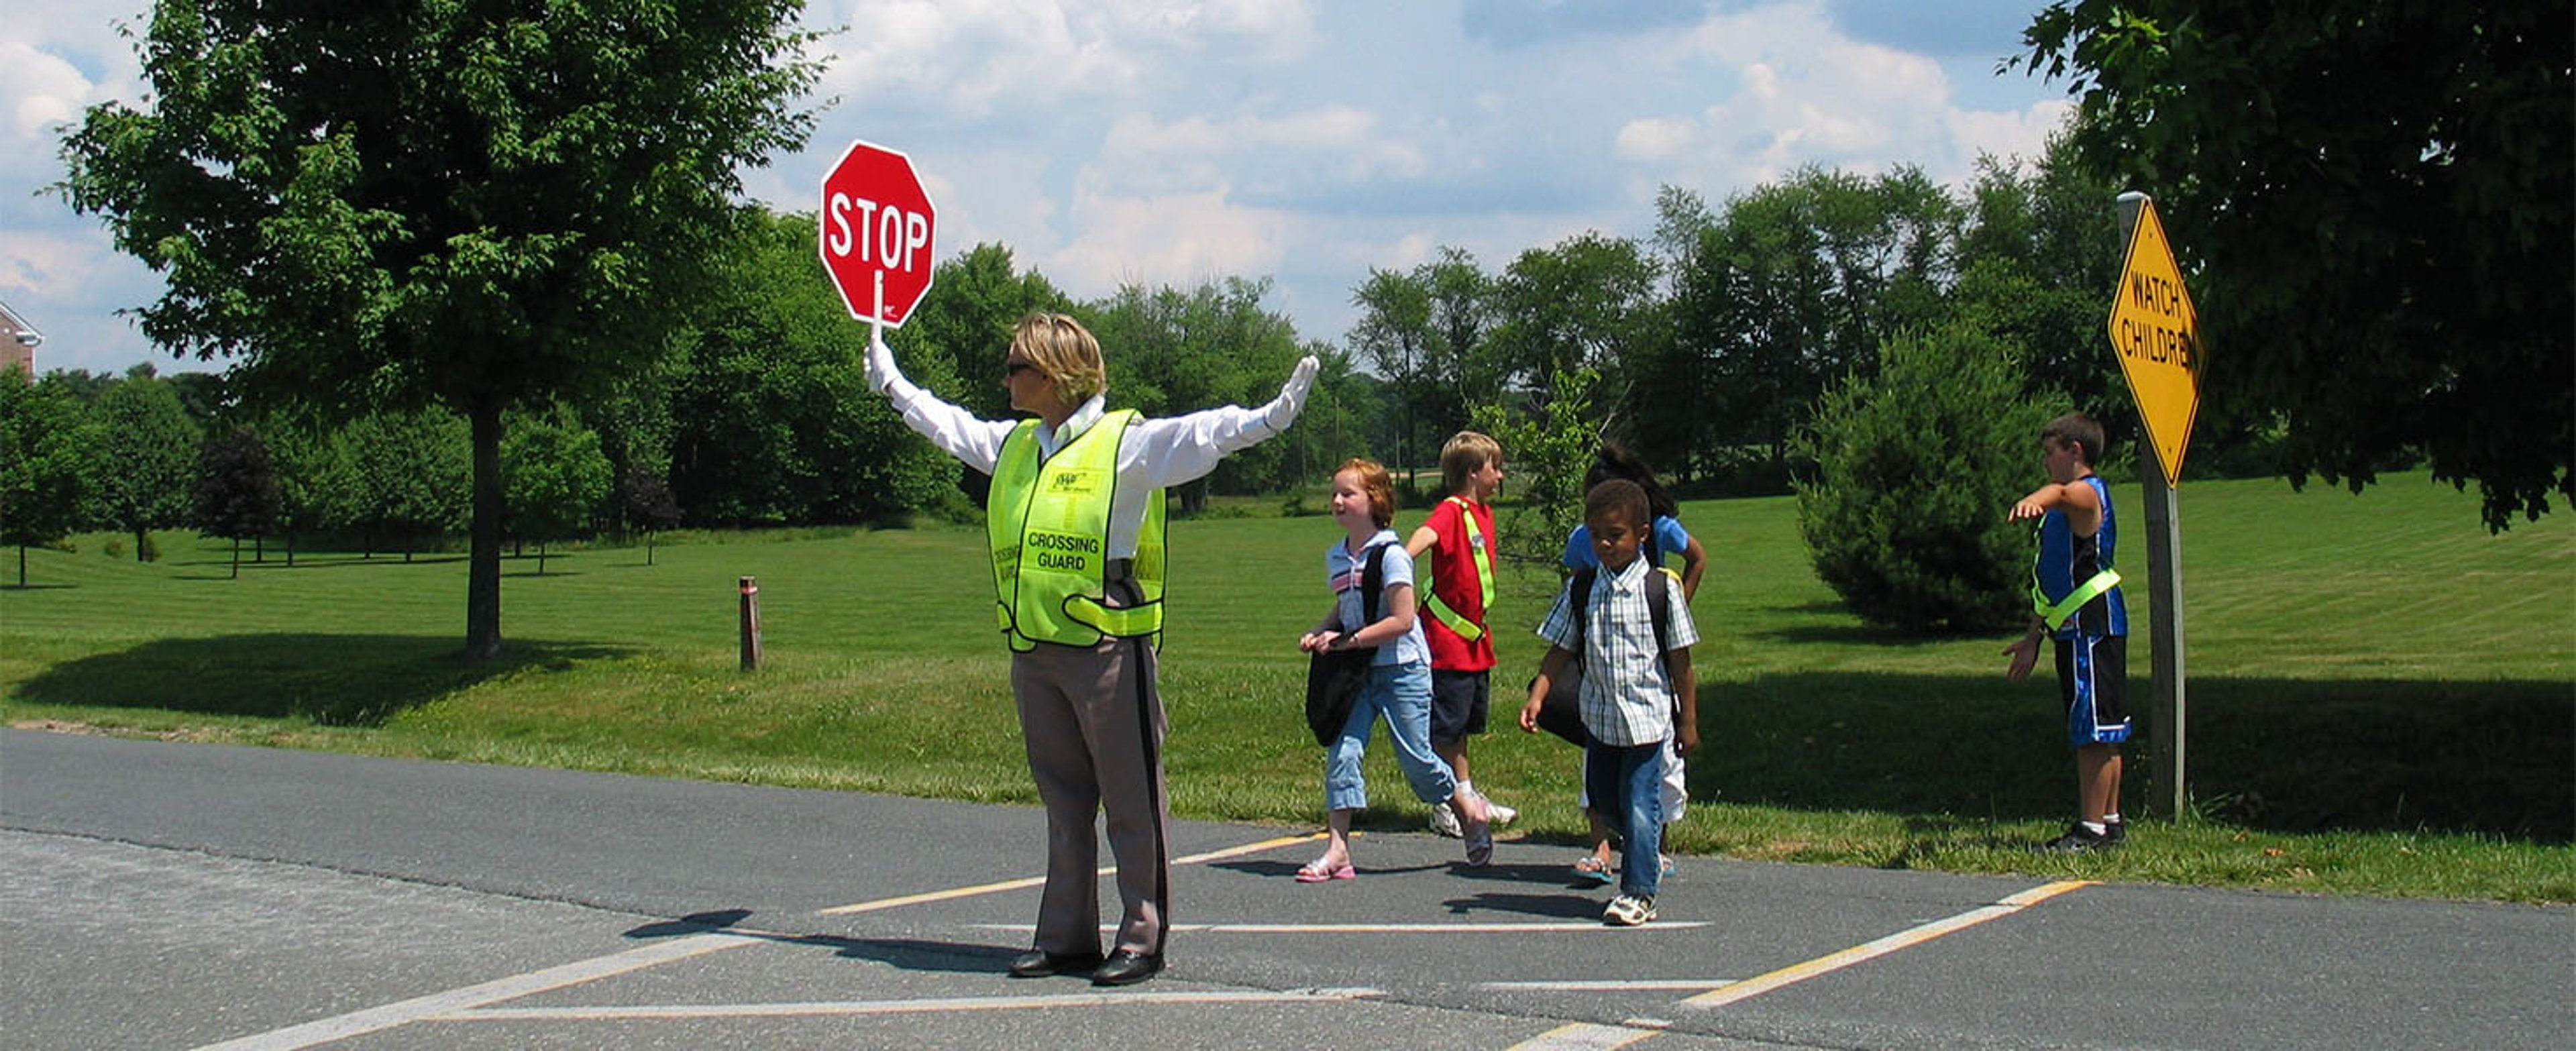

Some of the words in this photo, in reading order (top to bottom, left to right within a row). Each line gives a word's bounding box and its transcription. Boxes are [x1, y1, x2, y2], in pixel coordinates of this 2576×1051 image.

[830, 192, 928, 272] STOP
[2131, 270, 2180, 319] WATCH
[1028, 532, 1099, 553] CROSSING
[1038, 552, 1085, 570] GUARD
